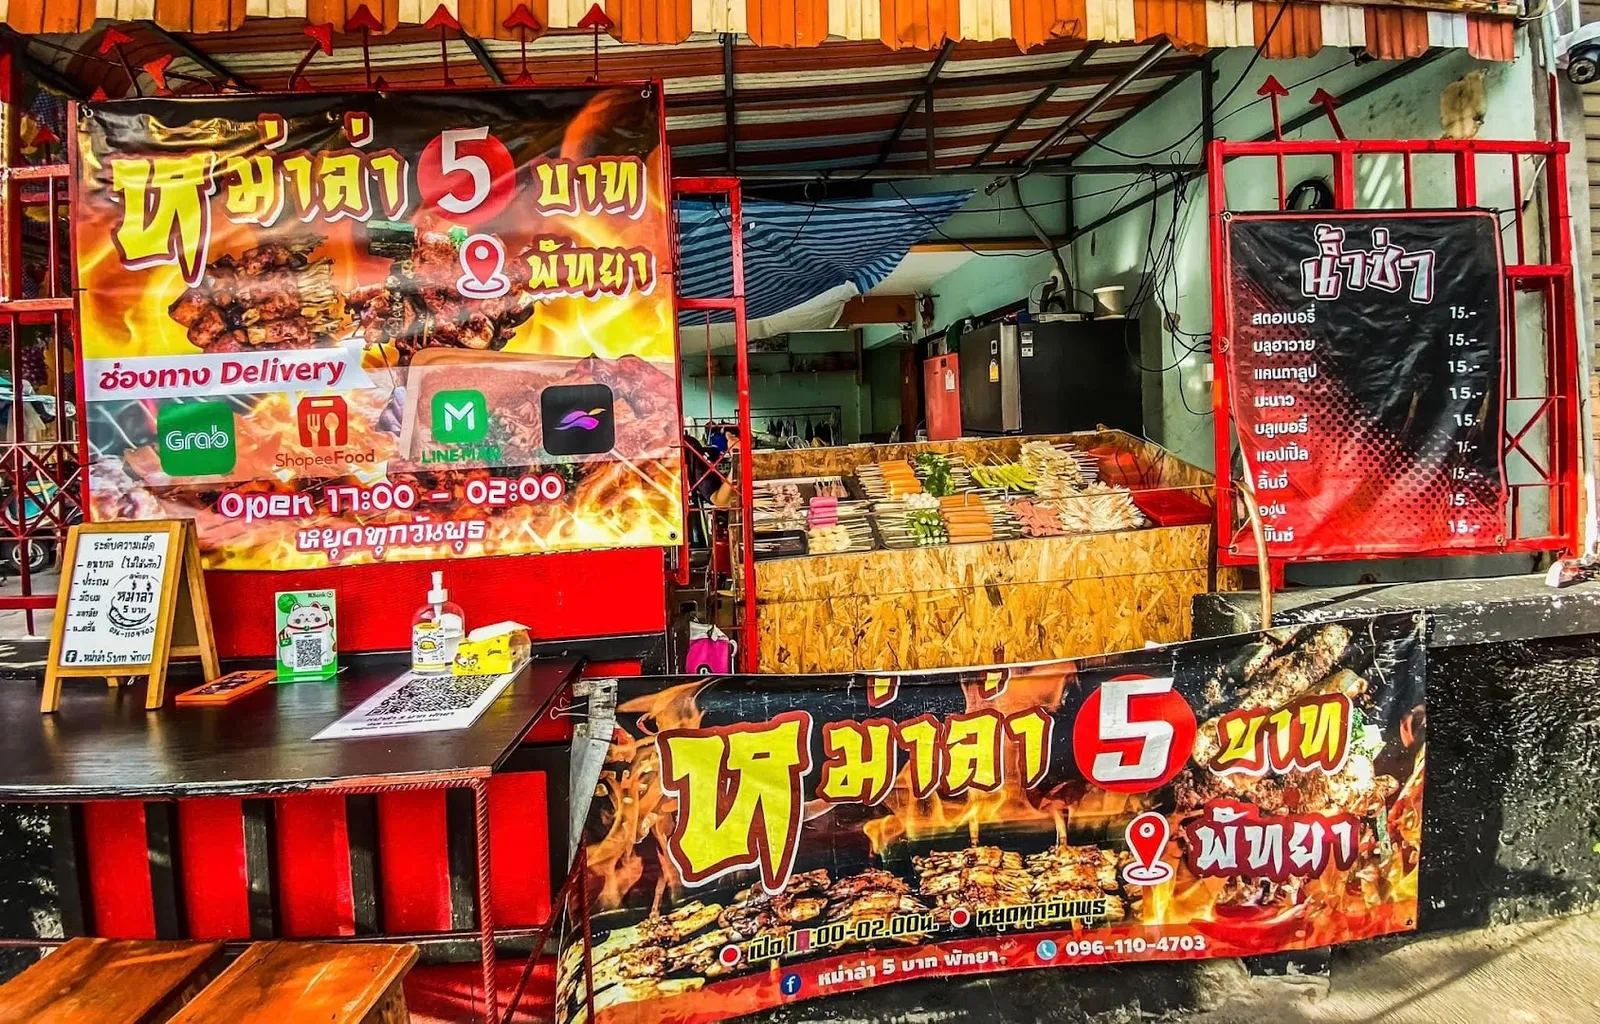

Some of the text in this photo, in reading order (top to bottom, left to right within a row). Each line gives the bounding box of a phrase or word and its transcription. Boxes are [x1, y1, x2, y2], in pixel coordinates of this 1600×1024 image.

[110, 112, 647, 287] หม่าล่า 5 บาท
[525, 236, 655, 300] พัทยา
[99, 357, 346, 391] ช่องทาง Delivery
[1254, 394, 1296, 408] มะนาว
[165, 424, 230, 451] Grab
[1254, 412, 1309, 439] บลูเบอรี่
[275, 449, 376, 471] ShopeeFood
[421, 449, 459, 464] LINE
[1256, 441, 1309, 462] แอปเปิ้ล
[1257, 468, 1289, 490] ลิ้นจี่
[219, 491, 314, 523] Open
[327, 484, 415, 512] 17:00
[466, 476, 564, 504] 02:00
[298, 516, 486, 557] หยุดทุกวันพุธ
[656, 675, 1353, 896] หม่าล่า 5 บาท
[1191, 803, 1358, 880] พัทยา
[787, 913, 940, 953] 1.00-02.00น.
[976, 896, 1107, 931] หยุดทุกวันพุธ
[1065, 934, 1206, 957] 096-110-4703
[818, 961, 876, 987] หม่าล่า
[883, 958, 896, 975] 5
[901, 955, 938, 972] บาท
